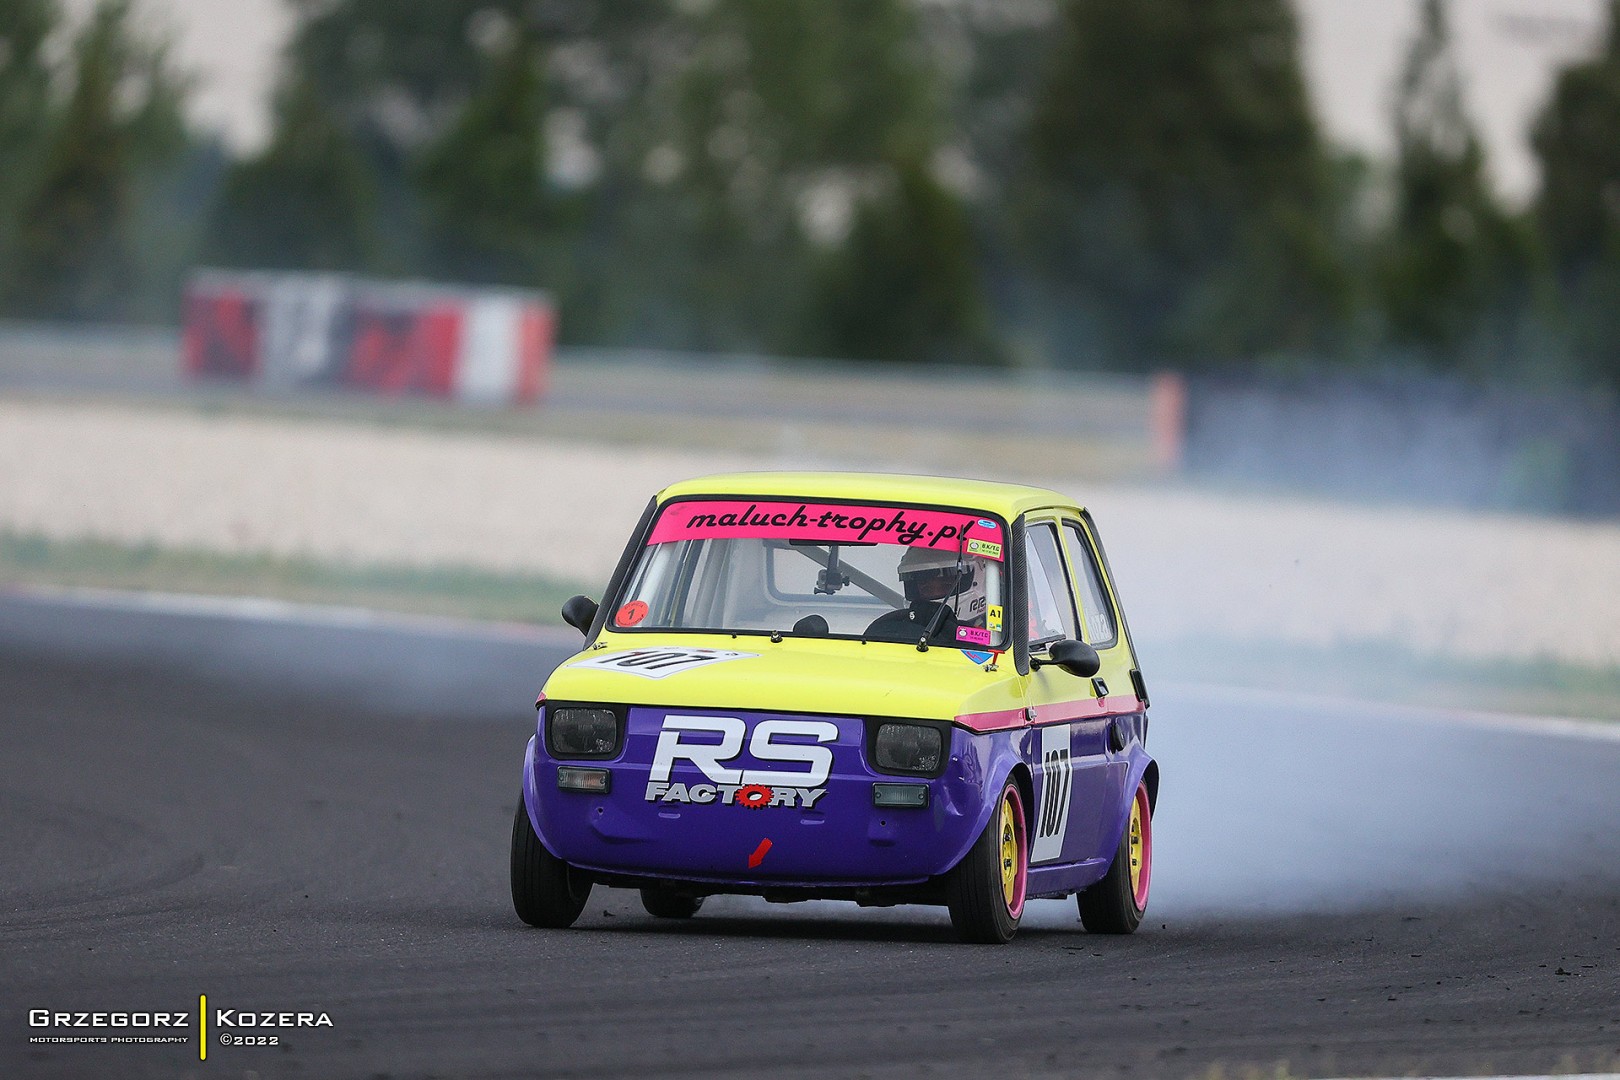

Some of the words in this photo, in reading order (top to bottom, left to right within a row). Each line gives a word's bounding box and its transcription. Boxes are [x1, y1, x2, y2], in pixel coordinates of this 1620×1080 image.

[686, 505, 975, 547] maluch-trophy.pl
[989, 609, 1001, 618] A1
[597, 650, 718, 671] 107
[649, 714, 839, 788] RS
[644, 781, 830, 810] FACTORY
[1039, 748, 1069, 838] 107
